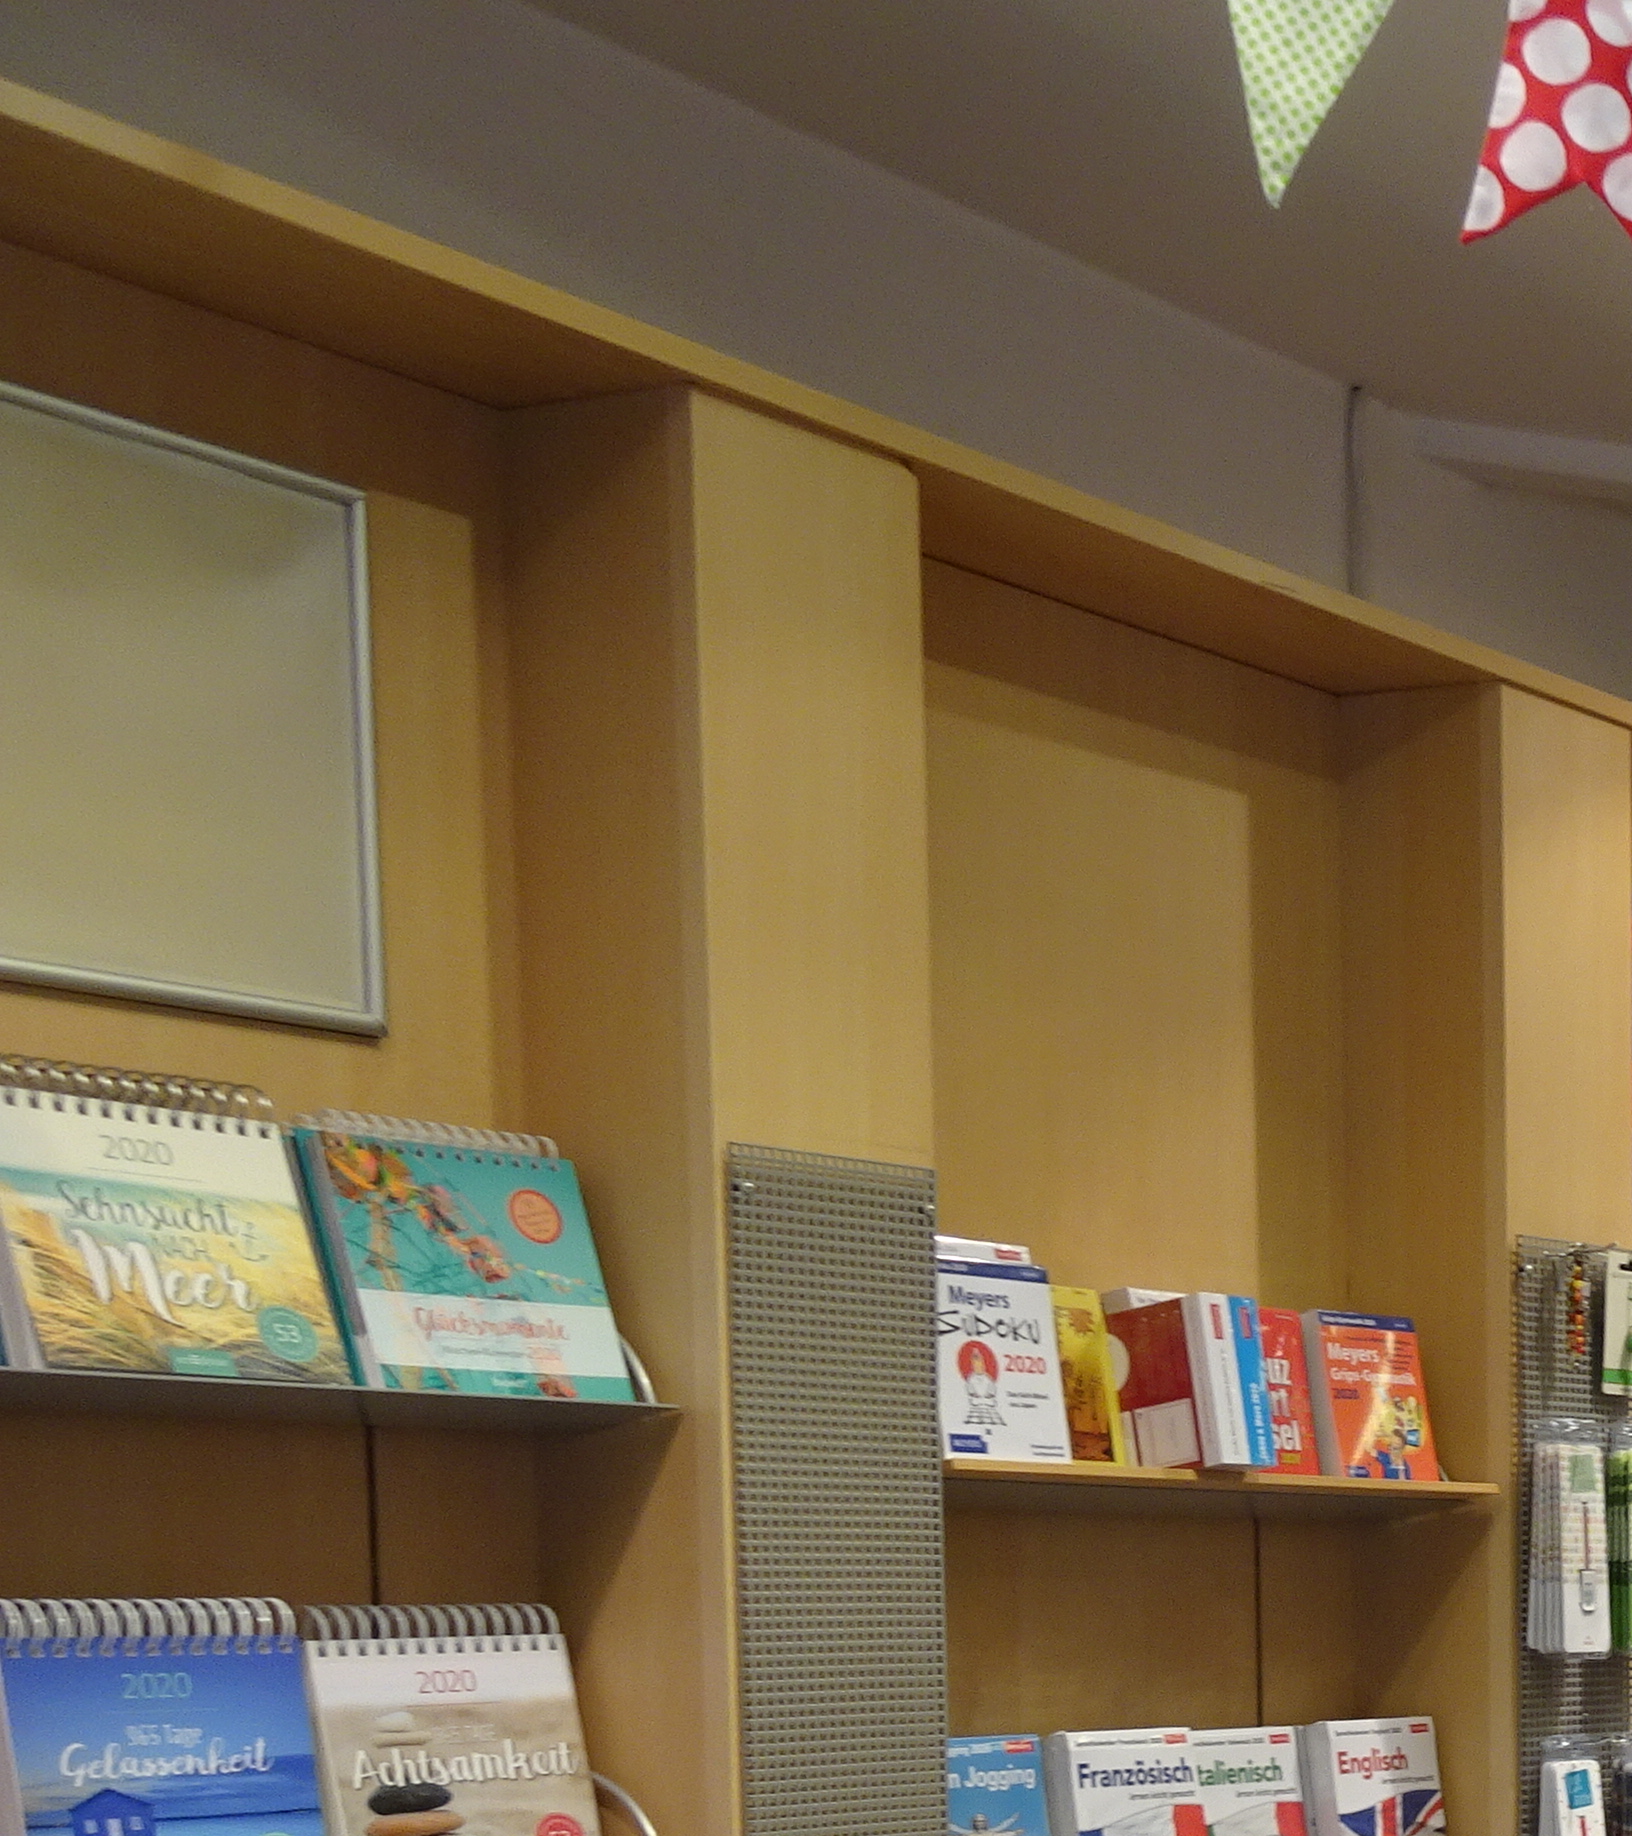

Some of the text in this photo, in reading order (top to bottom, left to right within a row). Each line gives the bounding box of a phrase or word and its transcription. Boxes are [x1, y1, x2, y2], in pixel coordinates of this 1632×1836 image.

[101, 1134, 174, 1166] 2020
[56, 1178, 240, 1238] Sehnsucht
[71, 1228, 258, 1328] Meer
[947, 1284, 1012, 1312] Meyers
[1003, 1354, 1047, 1375] 2020
[1327, 1342, 1380, 1366] Meyers
[123, 1671, 194, 1700] 2020
[415, 1670, 478, 1694] 2020
[60, 1736, 274, 1787] Gelassenheit
[352, 1737, 579, 1791] Achtsamkeit
[1076, 1757, 1194, 1789] Französisch
[1196, 1757, 1284, 1787] talienisch
[1336, 1747, 1409, 1780] Englisch
[964, 1764, 1037, 1792] Jogging
